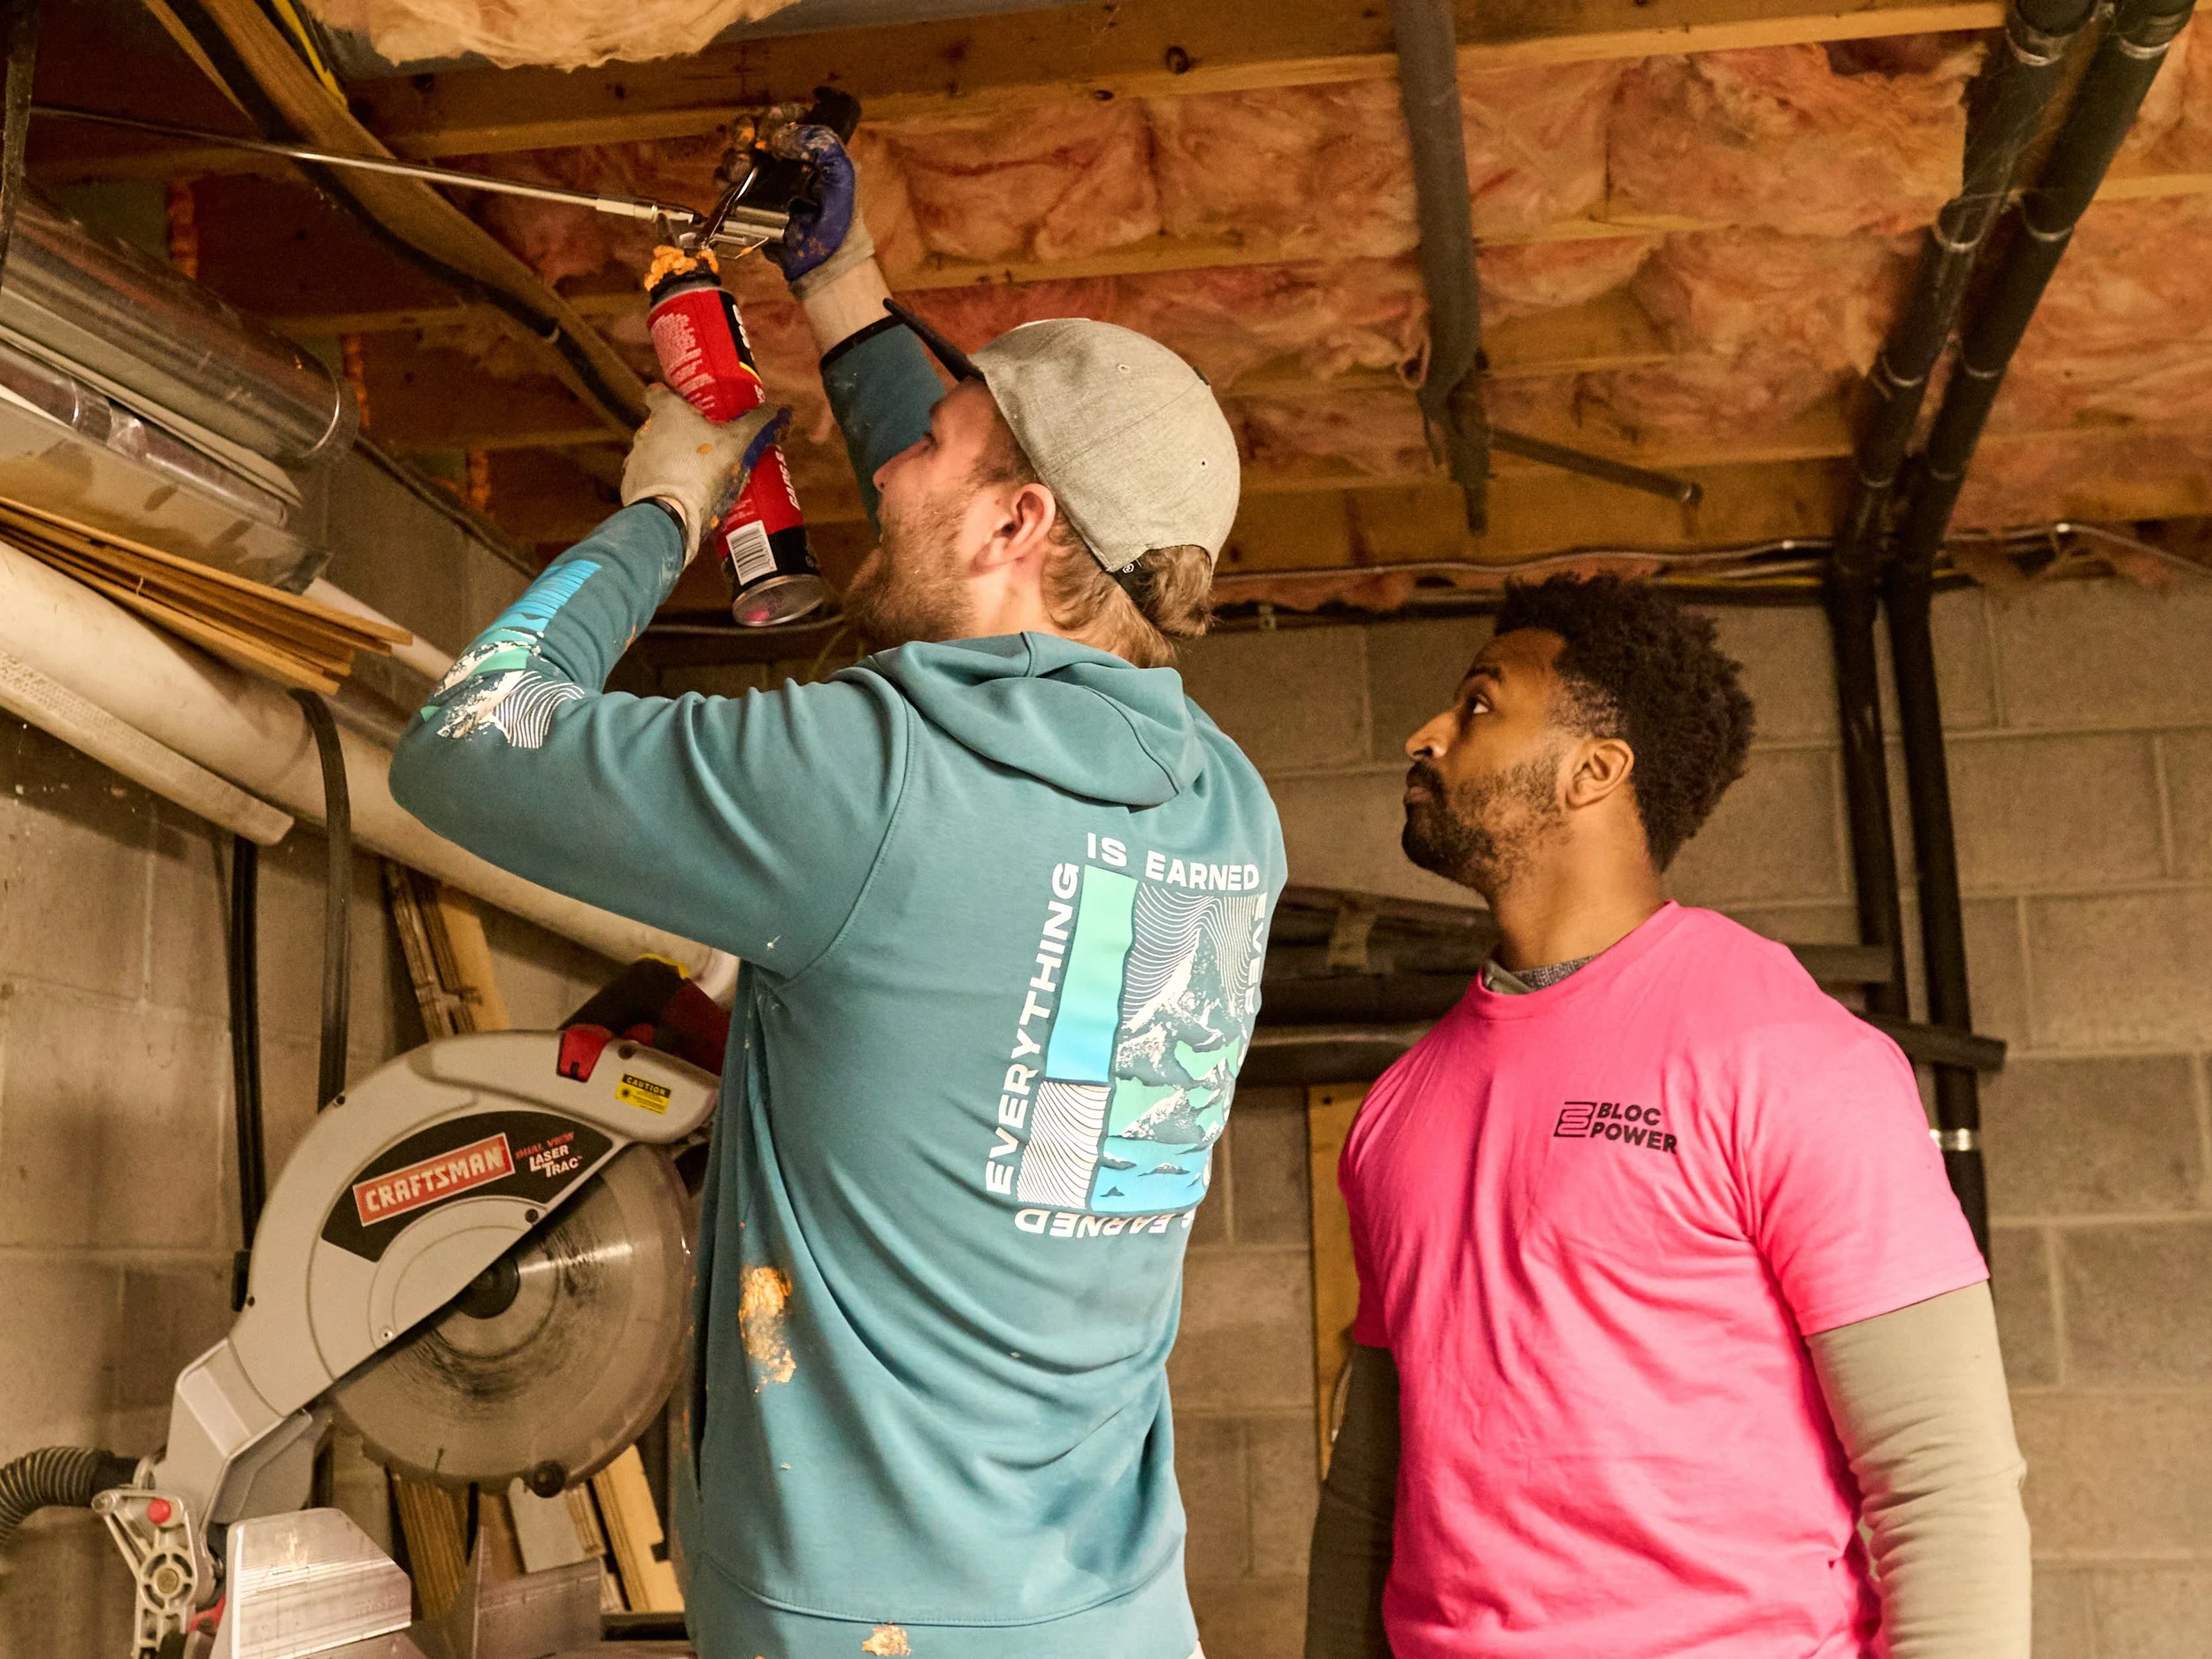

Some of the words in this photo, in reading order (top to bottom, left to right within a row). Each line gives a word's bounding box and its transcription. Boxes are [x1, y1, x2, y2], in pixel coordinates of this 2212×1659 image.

[1087, 832, 1127, 866] IS
[1145, 850, 1260, 891] EARNED
[986, 863, 1079, 1195] EVERYTHING
[626, 1075, 668, 1096] CAUTION
[1597, 1102, 1661, 1125] BLOC
[546, 1132, 574, 1148] VIEW
[1590, 1122, 1678, 1154] POWER
[529, 1145, 569, 1172] LASER
[365, 1145, 506, 1213] CRAFTSMAN
[1014, 1209, 1176, 1238] EARNED
